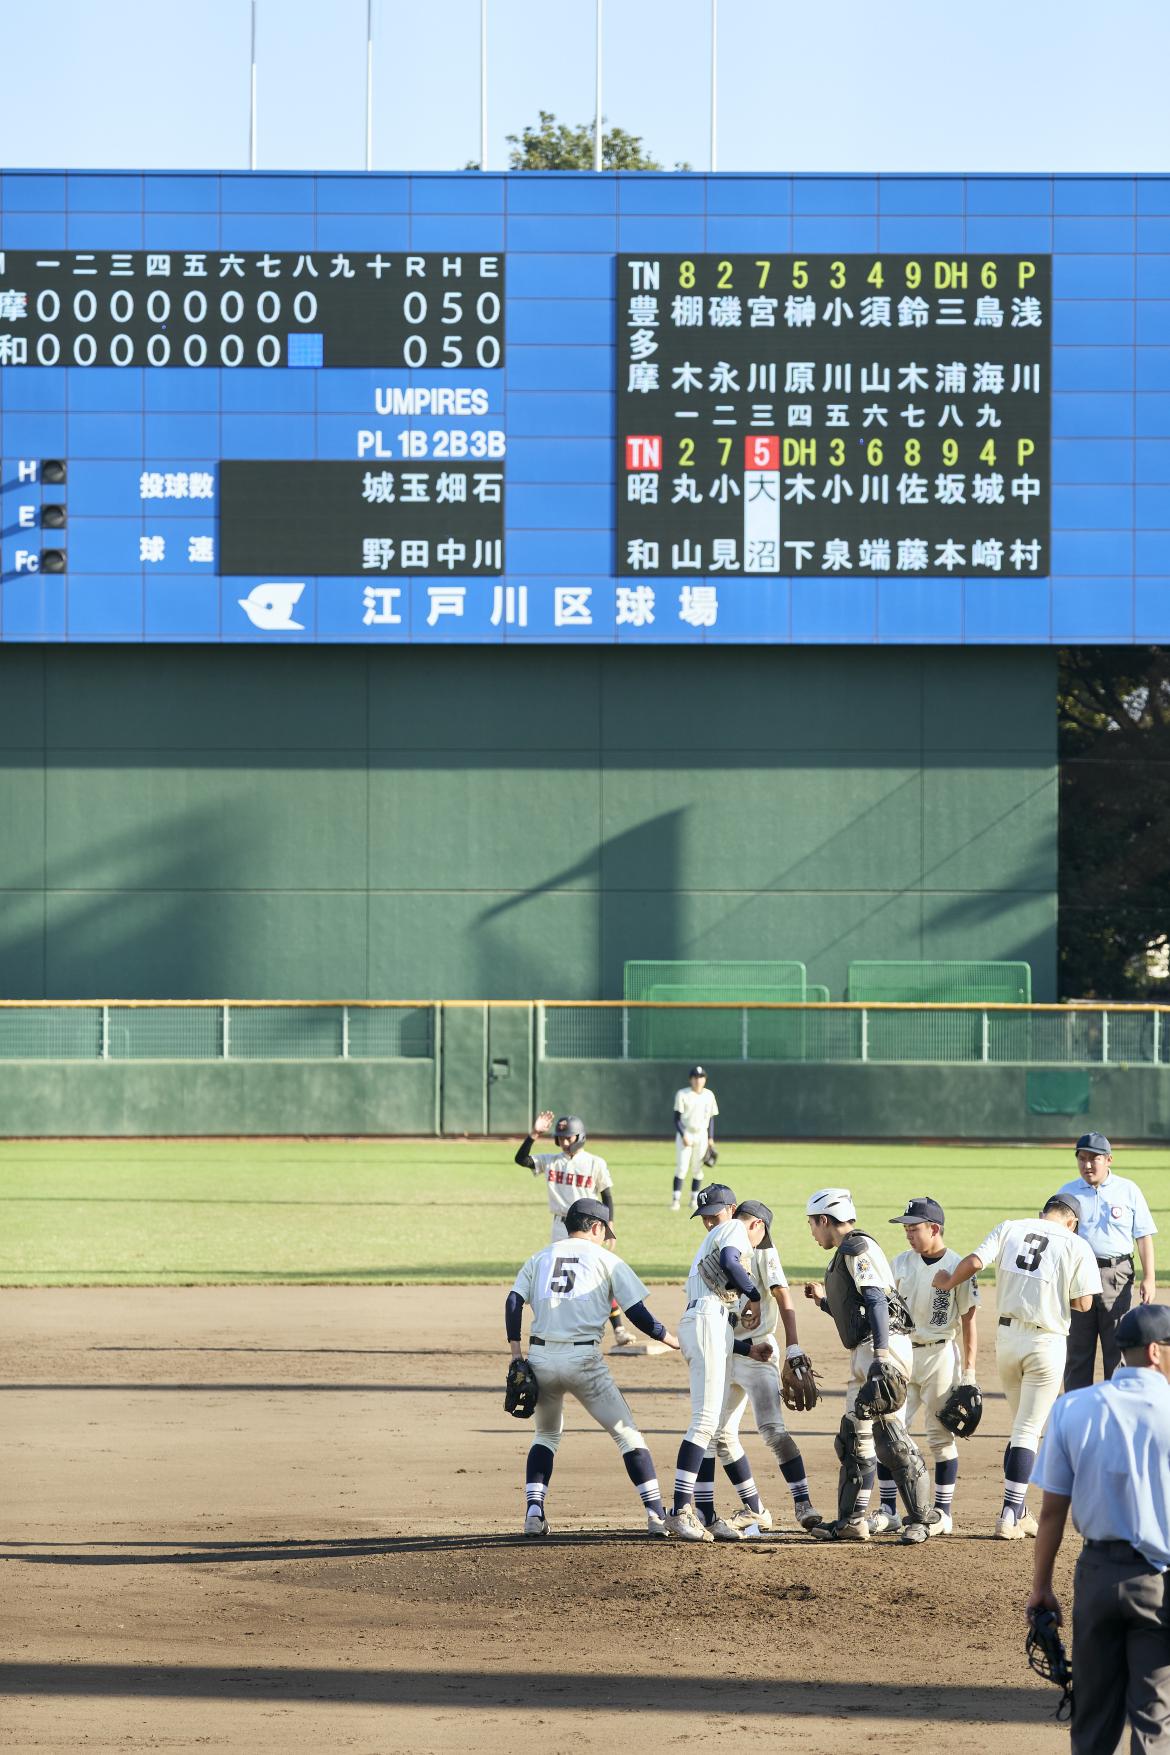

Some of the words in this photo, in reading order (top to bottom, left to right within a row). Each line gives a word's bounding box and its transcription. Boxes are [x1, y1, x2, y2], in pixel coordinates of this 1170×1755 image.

[73, 255, 97, 274] 二
[110, 255, 134, 275] 三
[147, 255, 170, 276] 四
[184, 255, 207, 276] 五
[220, 254, 245, 277] 六
[256, 254, 281, 277] 七
[293, 255, 318, 277] 八
[330, 254, 355, 277] 九
[367, 254, 391, 278] 十
[407, 257, 425, 277] R
[443, 257, 461, 277] H
[480, 257, 498, 277] E
[628, 262, 659, 290] TN
[679, 261, 695, 288] 8
[717, 261, 732, 288] 2
[756, 261, 770, 288] 7
[792, 261, 808, 289] 5
[830, 262, 845, 289] 3
[867, 262, 884, 288] 4
[906, 262, 921, 288] 9
[935, 262, 967, 289] DH
[981, 262, 996, 289] 6
[1019, 262, 1035, 288] P
[37, 290, 60, 322] 0
[74, 290, 97, 322] 0
[110, 290, 134, 322] 0
[147, 290, 170, 323] 0
[184, 291, 207, 322] 0
[221, 291, 244, 322] 0
[257, 291, 280, 323] 0
[294, 291, 317, 323] 0
[404, 292, 427, 323] 0
[442, 292, 462, 323] 5
[477, 292, 500, 323] 0
[37, 334, 60, 365] 0
[74, 334, 97, 365] 0
[110, 334, 133, 366] 0
[147, 334, 170, 366] 0
[184, 334, 207, 366] 0
[221, 335, 244, 366] 0
[257, 335, 280, 366] 0
[404, 335, 427, 367] 0
[442, 336, 462, 367] 5
[477, 336, 500, 367] 0
[375, 388, 489, 415] UMPIRES
[713, 406, 736, 425] 二
[750, 405, 774, 426] 三
[788, 405, 811, 426] 四
[826, 405, 849, 426] 五
[863, 404, 888, 427] 六
[901, 404, 925, 427] 七
[938, 405, 963, 427] 八
[976, 403, 1001, 427] 九
[358, 430, 392, 458] PL
[628, 438, 659, 467] TN
[679, 438, 694, 466] 2
[718, 438, 732, 466] 7
[754, 438, 770, 466] 5
[783, 438, 816, 466] DH
[830, 438, 845, 466] 3
[867, 439, 883, 466] 6
[905, 439, 920, 466] 8
[943, 439, 958, 466] 9
[980, 439, 996, 466] 4
[1018, 439, 1034, 466] P
[18, 460, 37, 481] H
[140, 472, 214, 499] 投球数
[19, 506, 35, 527] E
[15, 550, 38, 572] Fc
[363, 586, 718, 628] 江戸川区球場
[548, 1169, 593, 1189] SHOWA
[699, 1192, 708, 1205] T
[1016, 1232, 1049, 1272] 3
[549, 1257, 579, 1294] 5
